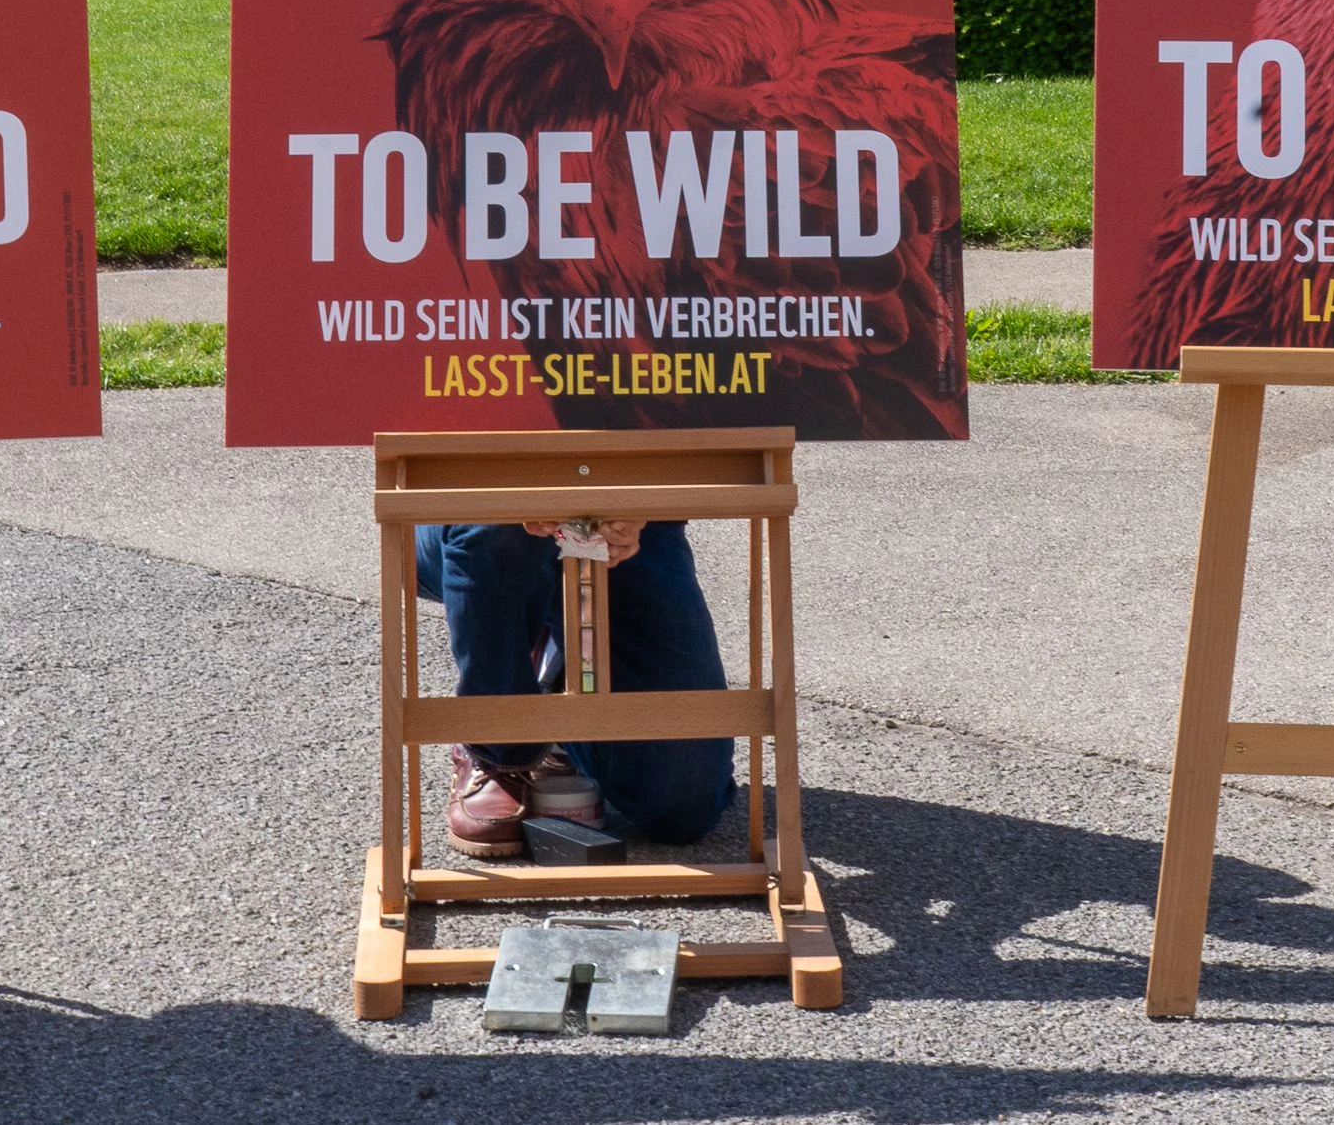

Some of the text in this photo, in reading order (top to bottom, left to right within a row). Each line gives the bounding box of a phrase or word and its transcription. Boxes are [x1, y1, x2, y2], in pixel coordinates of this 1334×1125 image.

[1159, 39, 1305, 179] TO
[289, 130, 900, 263] TO BE WILD
[1190, 218, 1282, 262] WILD
[318, 296, 874, 342] WILD SEIN IST KEIN VERBRECHEN.
[425, 353, 771, 397] LASST-SIE-LEBEN.AT
